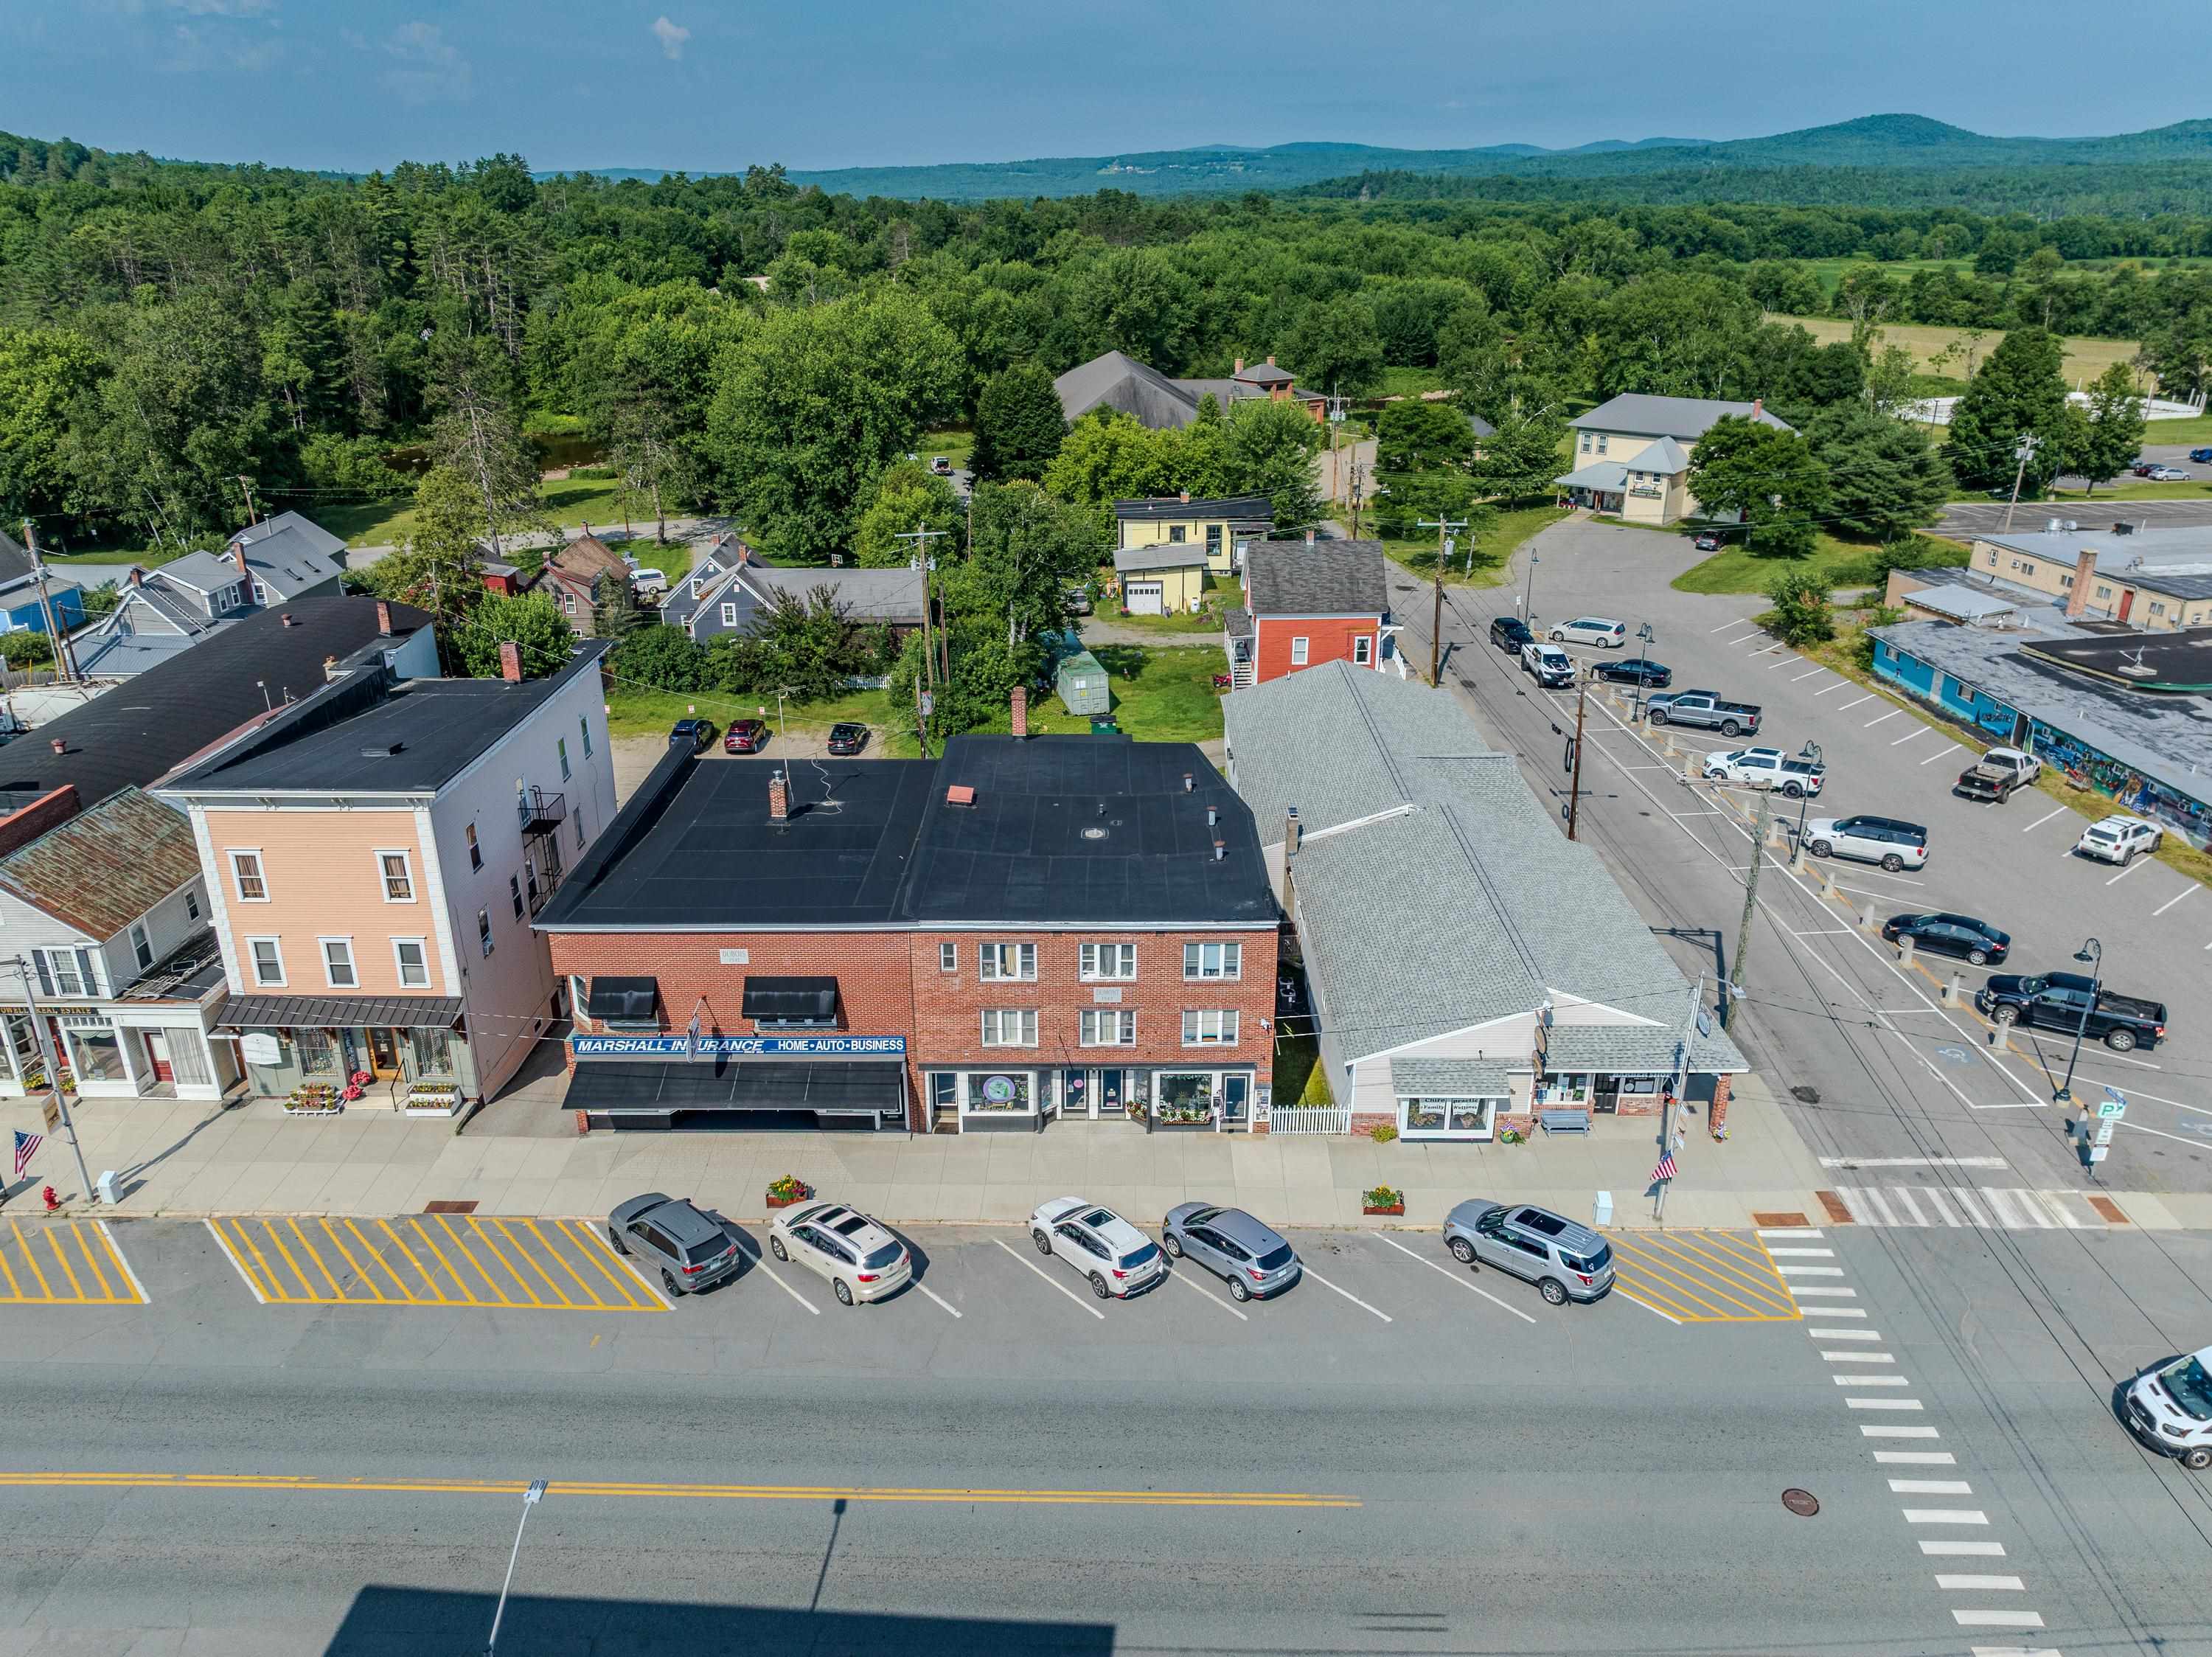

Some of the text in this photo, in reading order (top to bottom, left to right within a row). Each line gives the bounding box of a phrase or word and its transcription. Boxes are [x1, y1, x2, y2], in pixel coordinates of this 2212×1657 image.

[577, 1040, 904, 1052] MARSHALL INURANCE HOME AUTO BUSINESS
